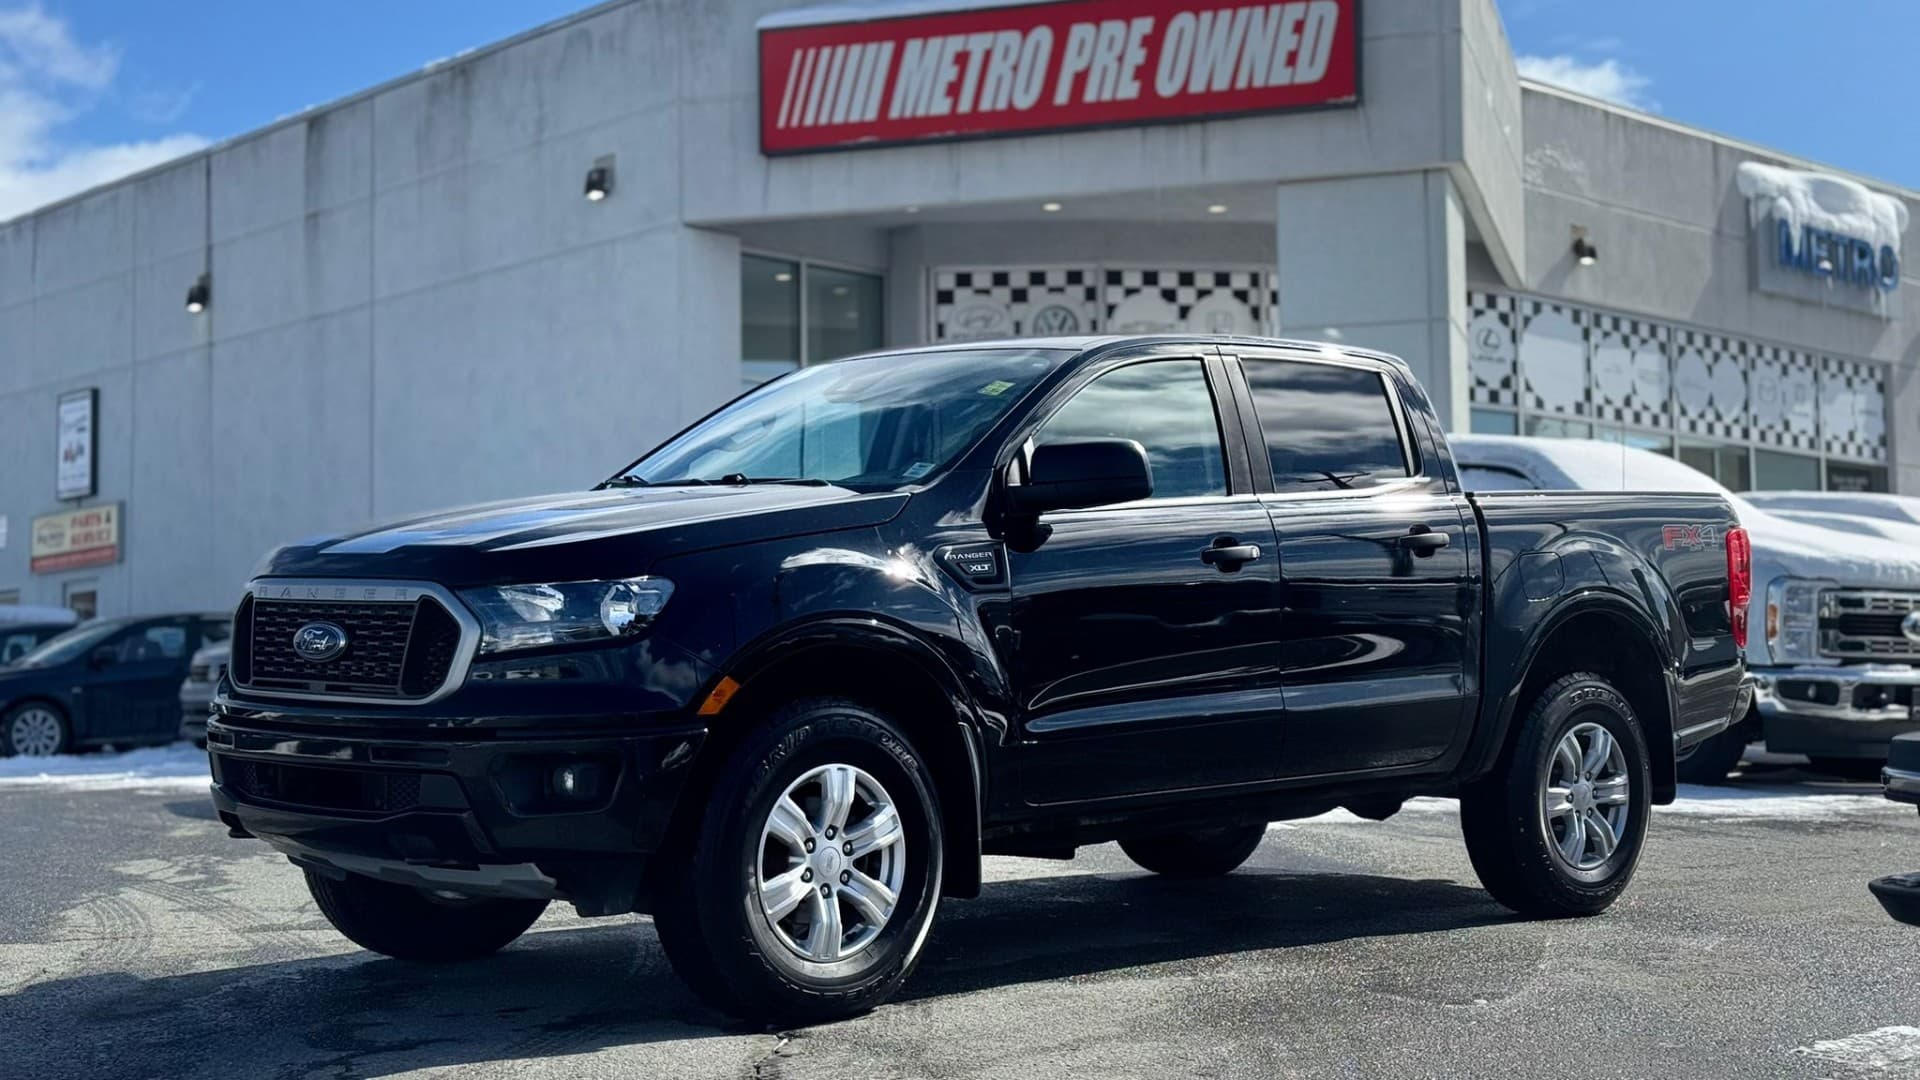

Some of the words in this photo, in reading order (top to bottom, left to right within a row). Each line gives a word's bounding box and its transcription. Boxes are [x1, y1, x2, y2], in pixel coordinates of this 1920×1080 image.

[887, 25, 1054, 120] METRO
[1052, 16, 1155, 106] PRE
[1155, 0, 1339, 98] OWNED
[1778, 217, 1900, 293] METRO
[1662, 524, 1719, 551] FX4
[949, 551, 993, 560] RANGER
[969, 563, 991, 572] XLT
[258, 586, 409, 600] RANGER
[301, 628, 335, 651] Ford
